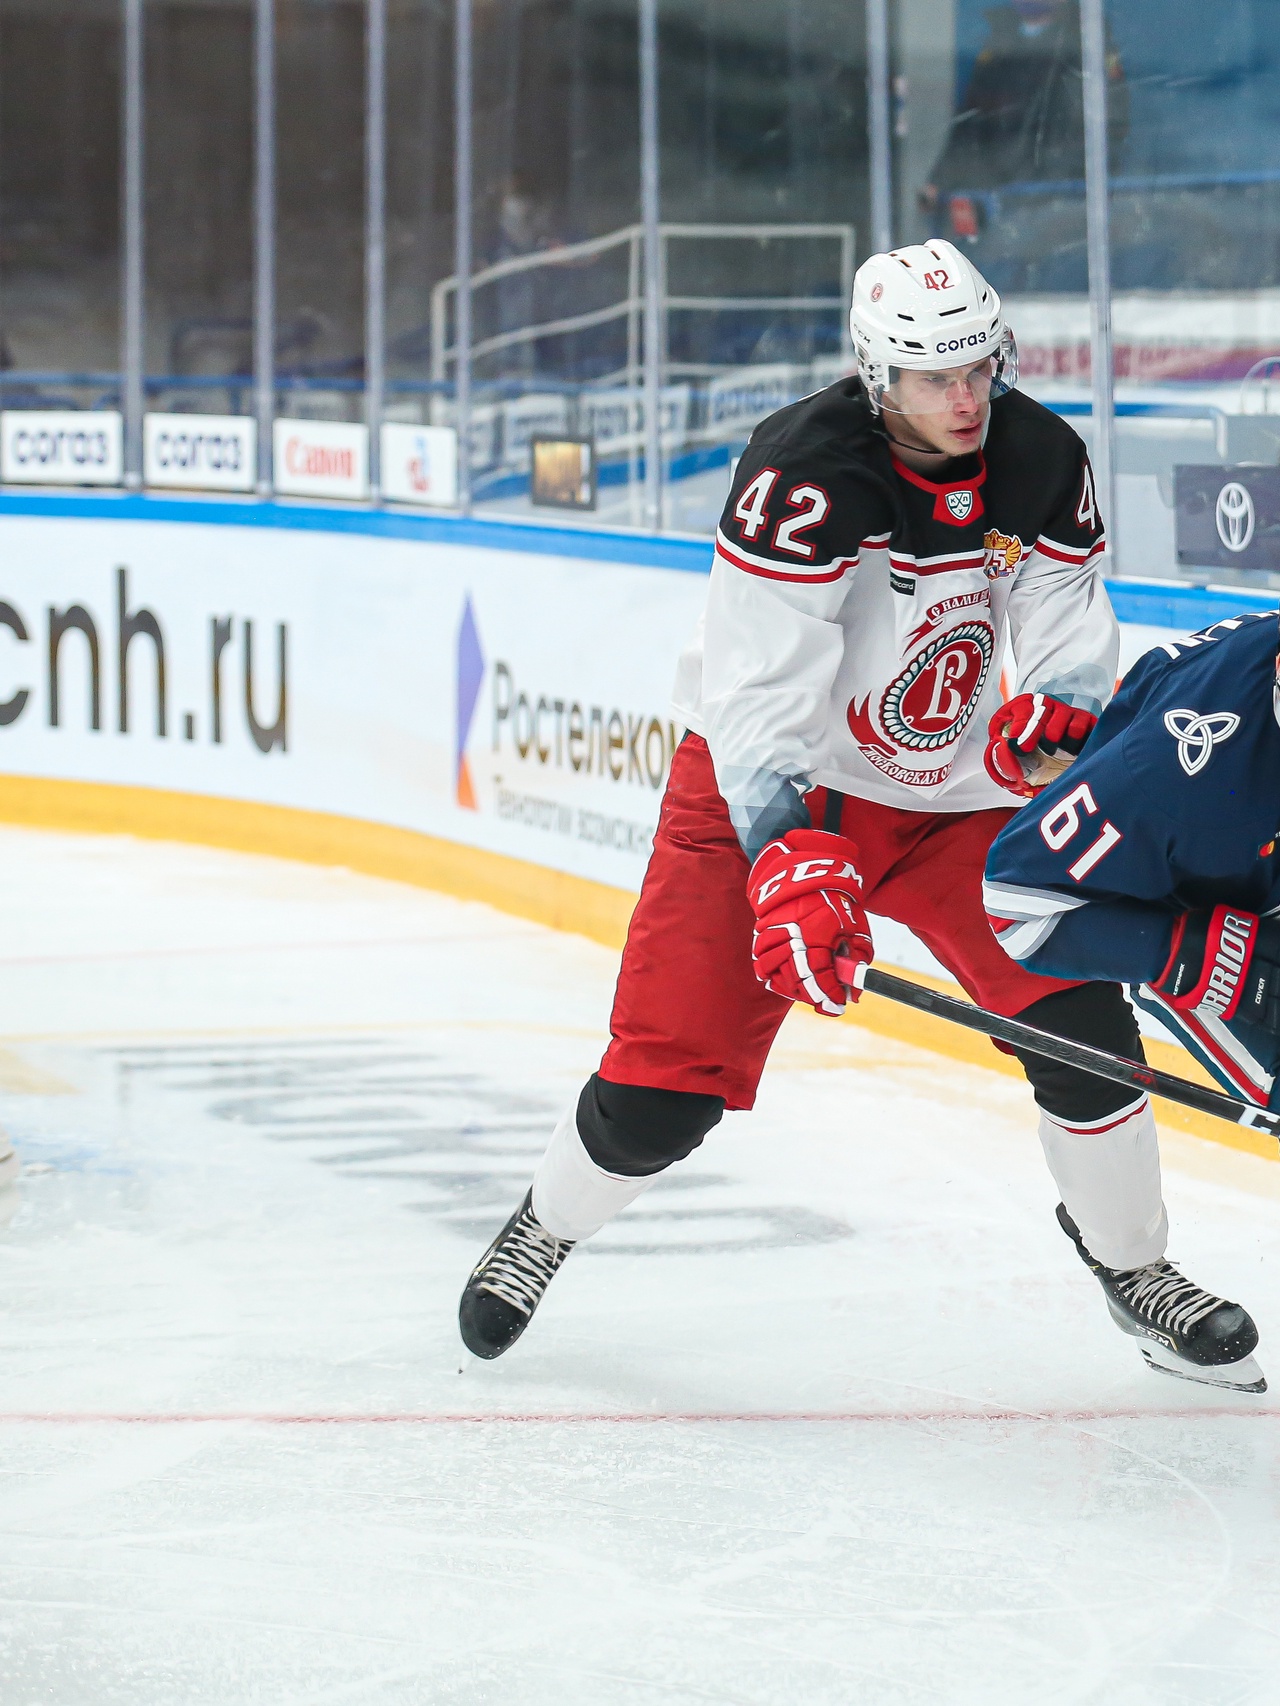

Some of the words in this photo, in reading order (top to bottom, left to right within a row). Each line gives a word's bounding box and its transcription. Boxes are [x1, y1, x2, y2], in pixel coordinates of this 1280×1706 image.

[924, 269, 956, 291] 42
[935, 331, 987, 354] согаз
[285, 437, 355, 479] Canon
[734, 466, 831, 560] 42
[984, 549, 1007, 571] 75
[492, 660, 676, 790] Ростелеко
[1040, 782, 1123, 883] 61
[757, 859, 863, 905] CCM
[1135, 1324, 1169, 1347] CCM
